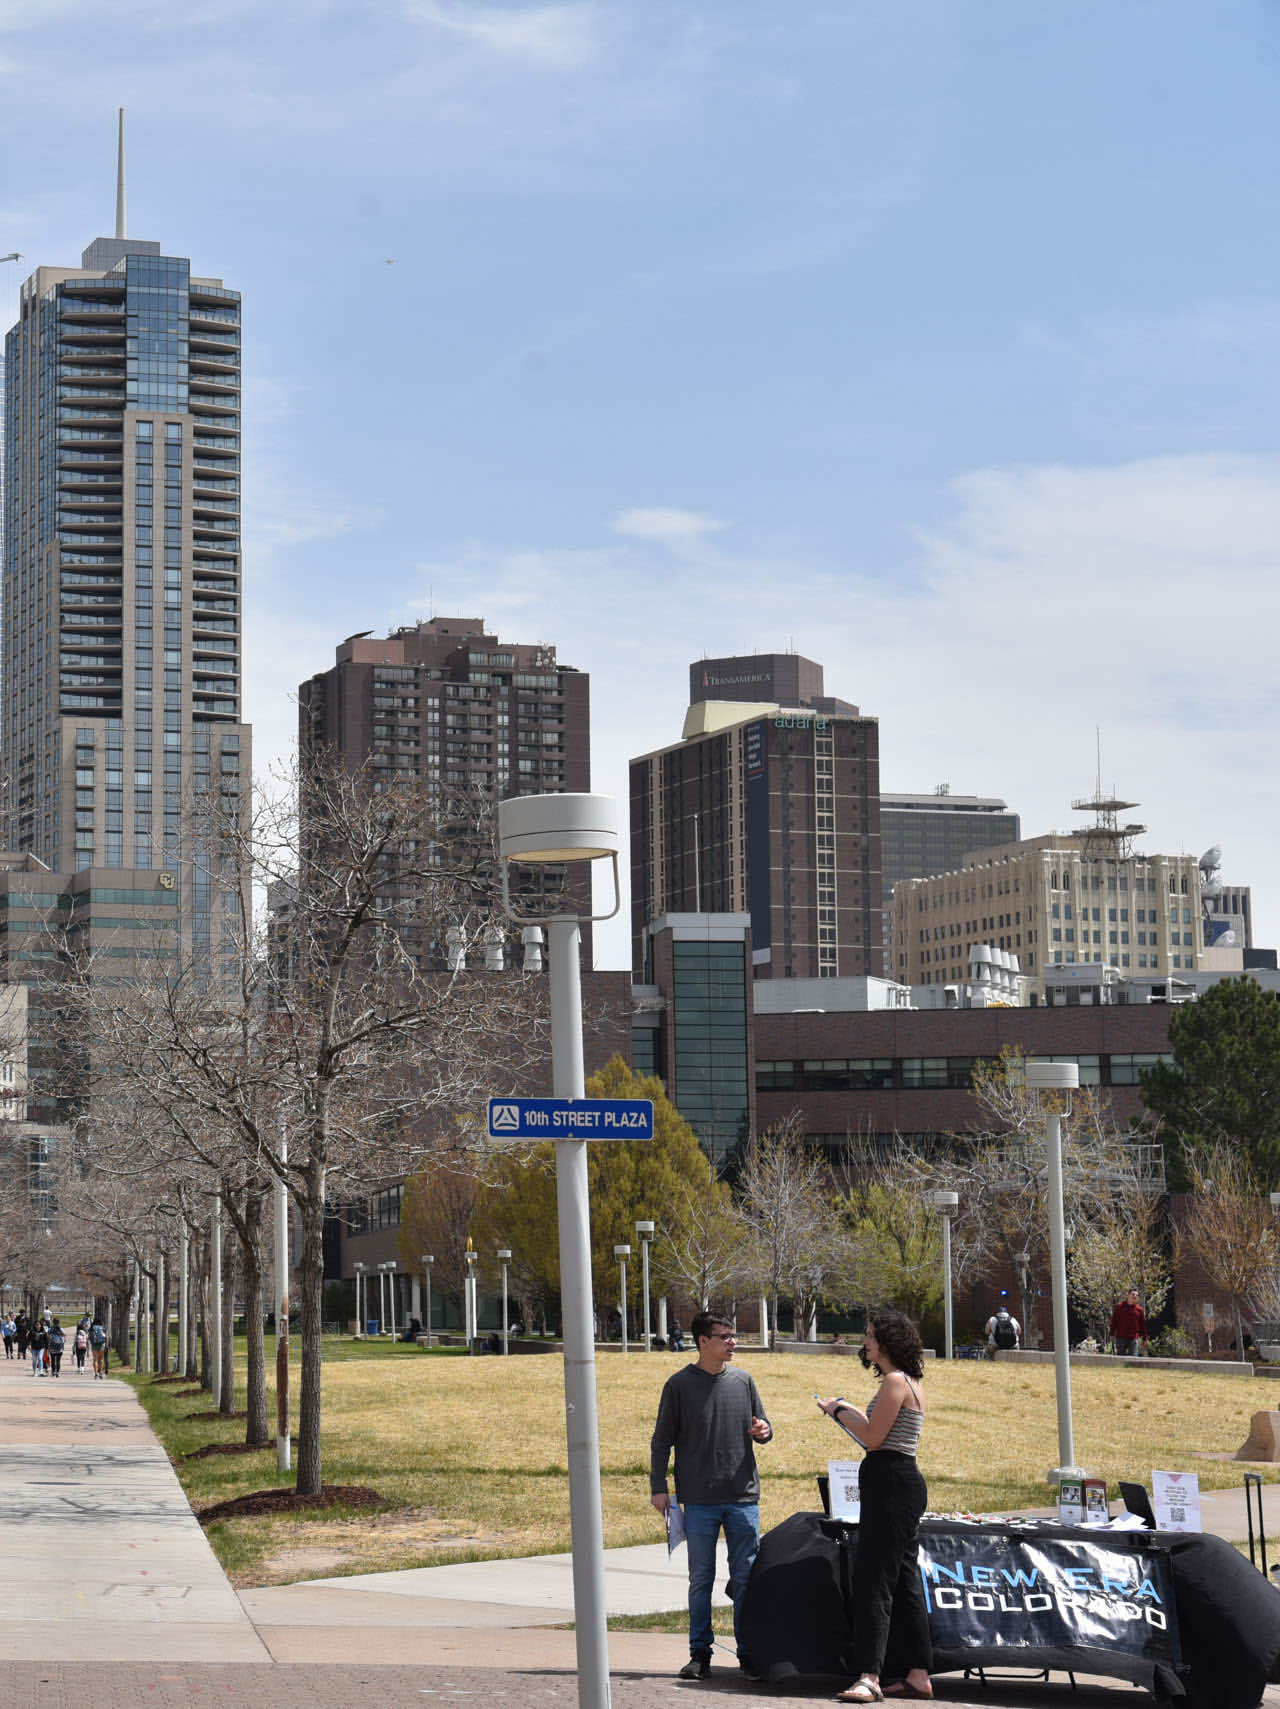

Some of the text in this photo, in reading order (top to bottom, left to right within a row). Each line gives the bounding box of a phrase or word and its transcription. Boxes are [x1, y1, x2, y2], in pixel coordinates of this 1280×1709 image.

[524, 1110, 648, 1128] 10th STREET PLAZA
[931, 1561, 1162, 1604] NEW ERA
